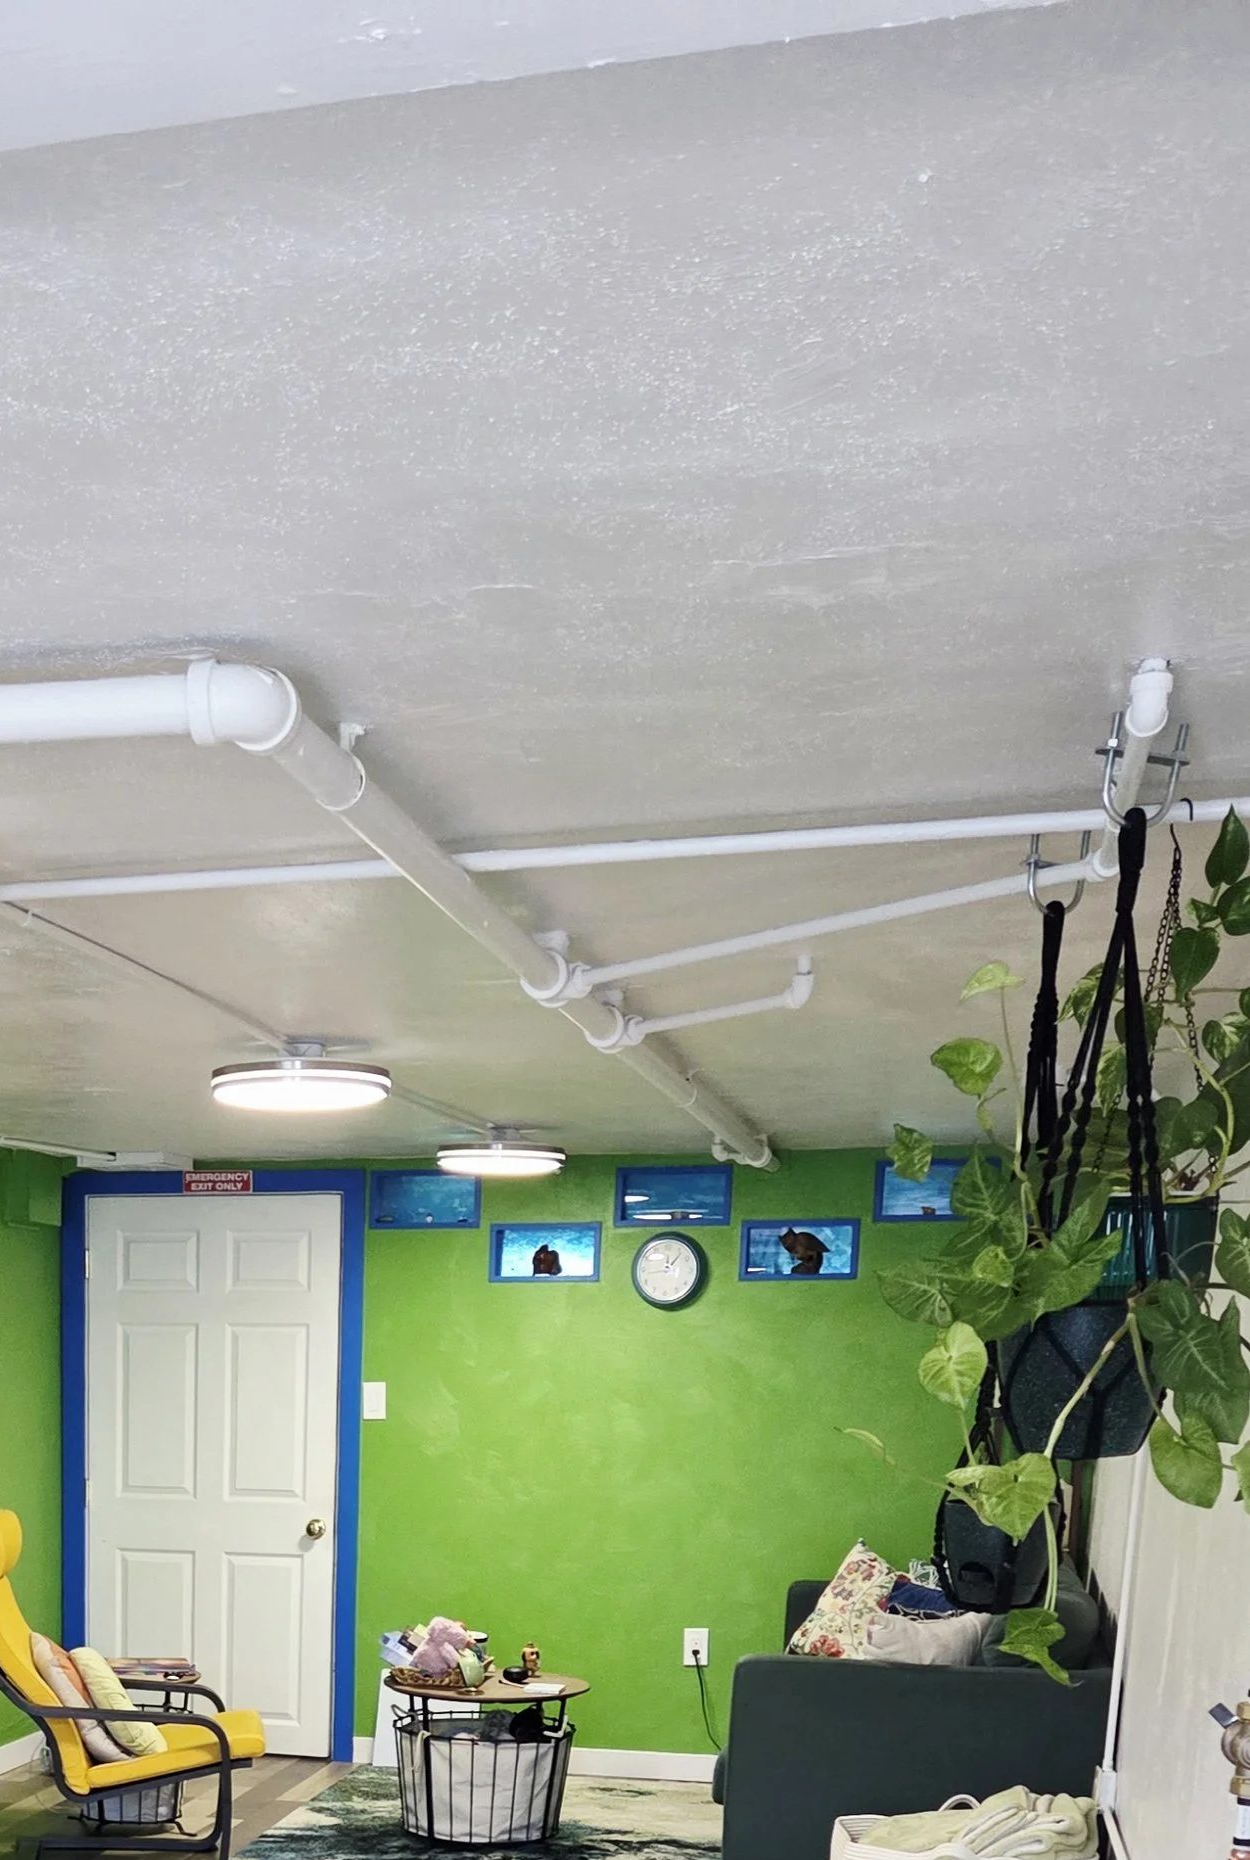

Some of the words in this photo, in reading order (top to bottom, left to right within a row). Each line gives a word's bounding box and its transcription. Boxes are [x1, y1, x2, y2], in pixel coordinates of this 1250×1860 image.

[185, 1173, 249, 1181] EMERGENCY
[191, 1182, 213, 1190] EXIT
[215, 1182, 243, 1190] ONLY
